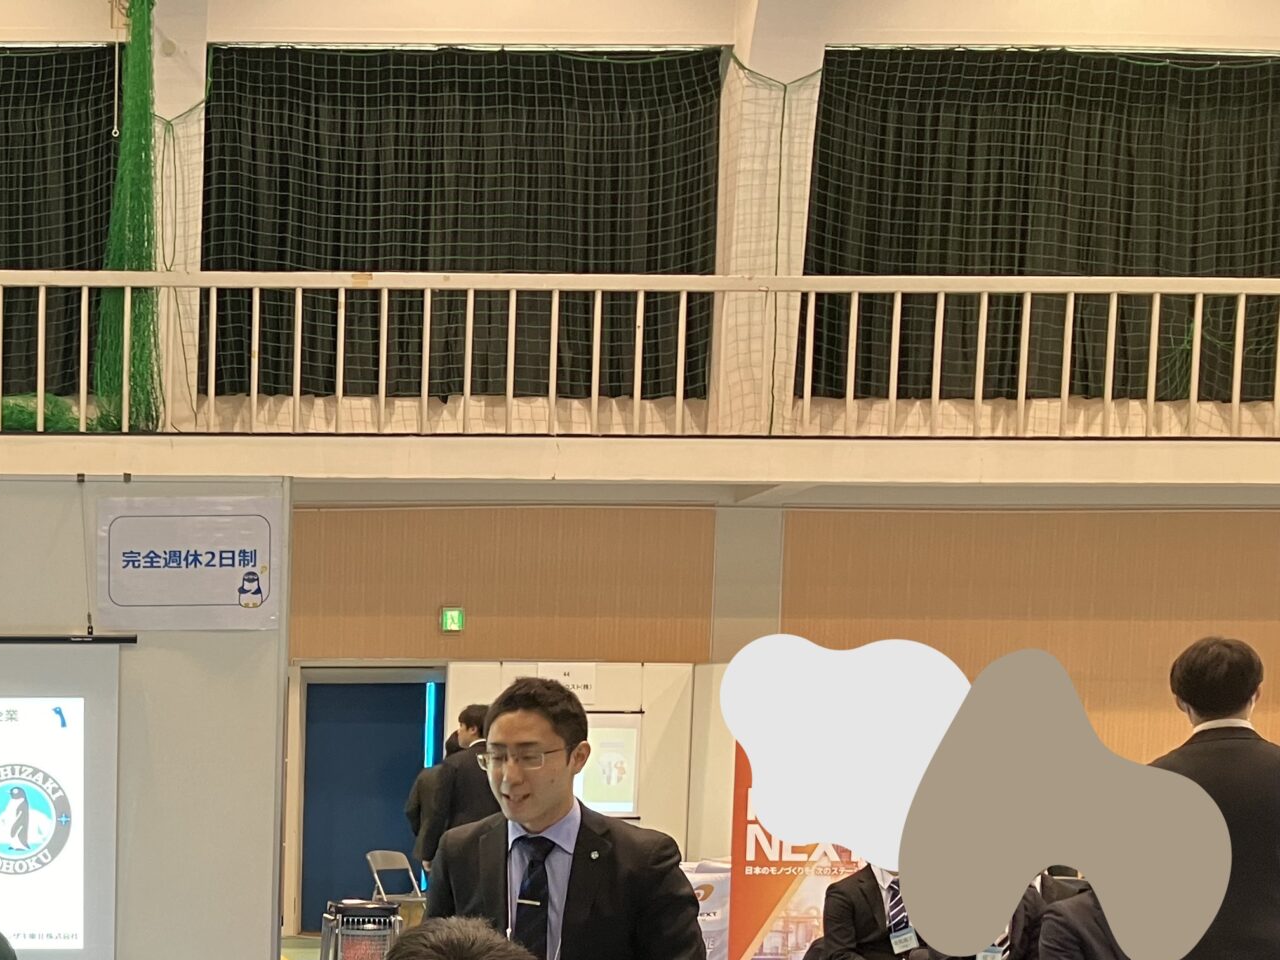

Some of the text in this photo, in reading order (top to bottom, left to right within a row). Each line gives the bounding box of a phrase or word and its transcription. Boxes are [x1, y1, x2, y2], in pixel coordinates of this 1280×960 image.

[122, 549, 257, 569] 完全週休2日制
[745, 824, 859, 862] NEX
